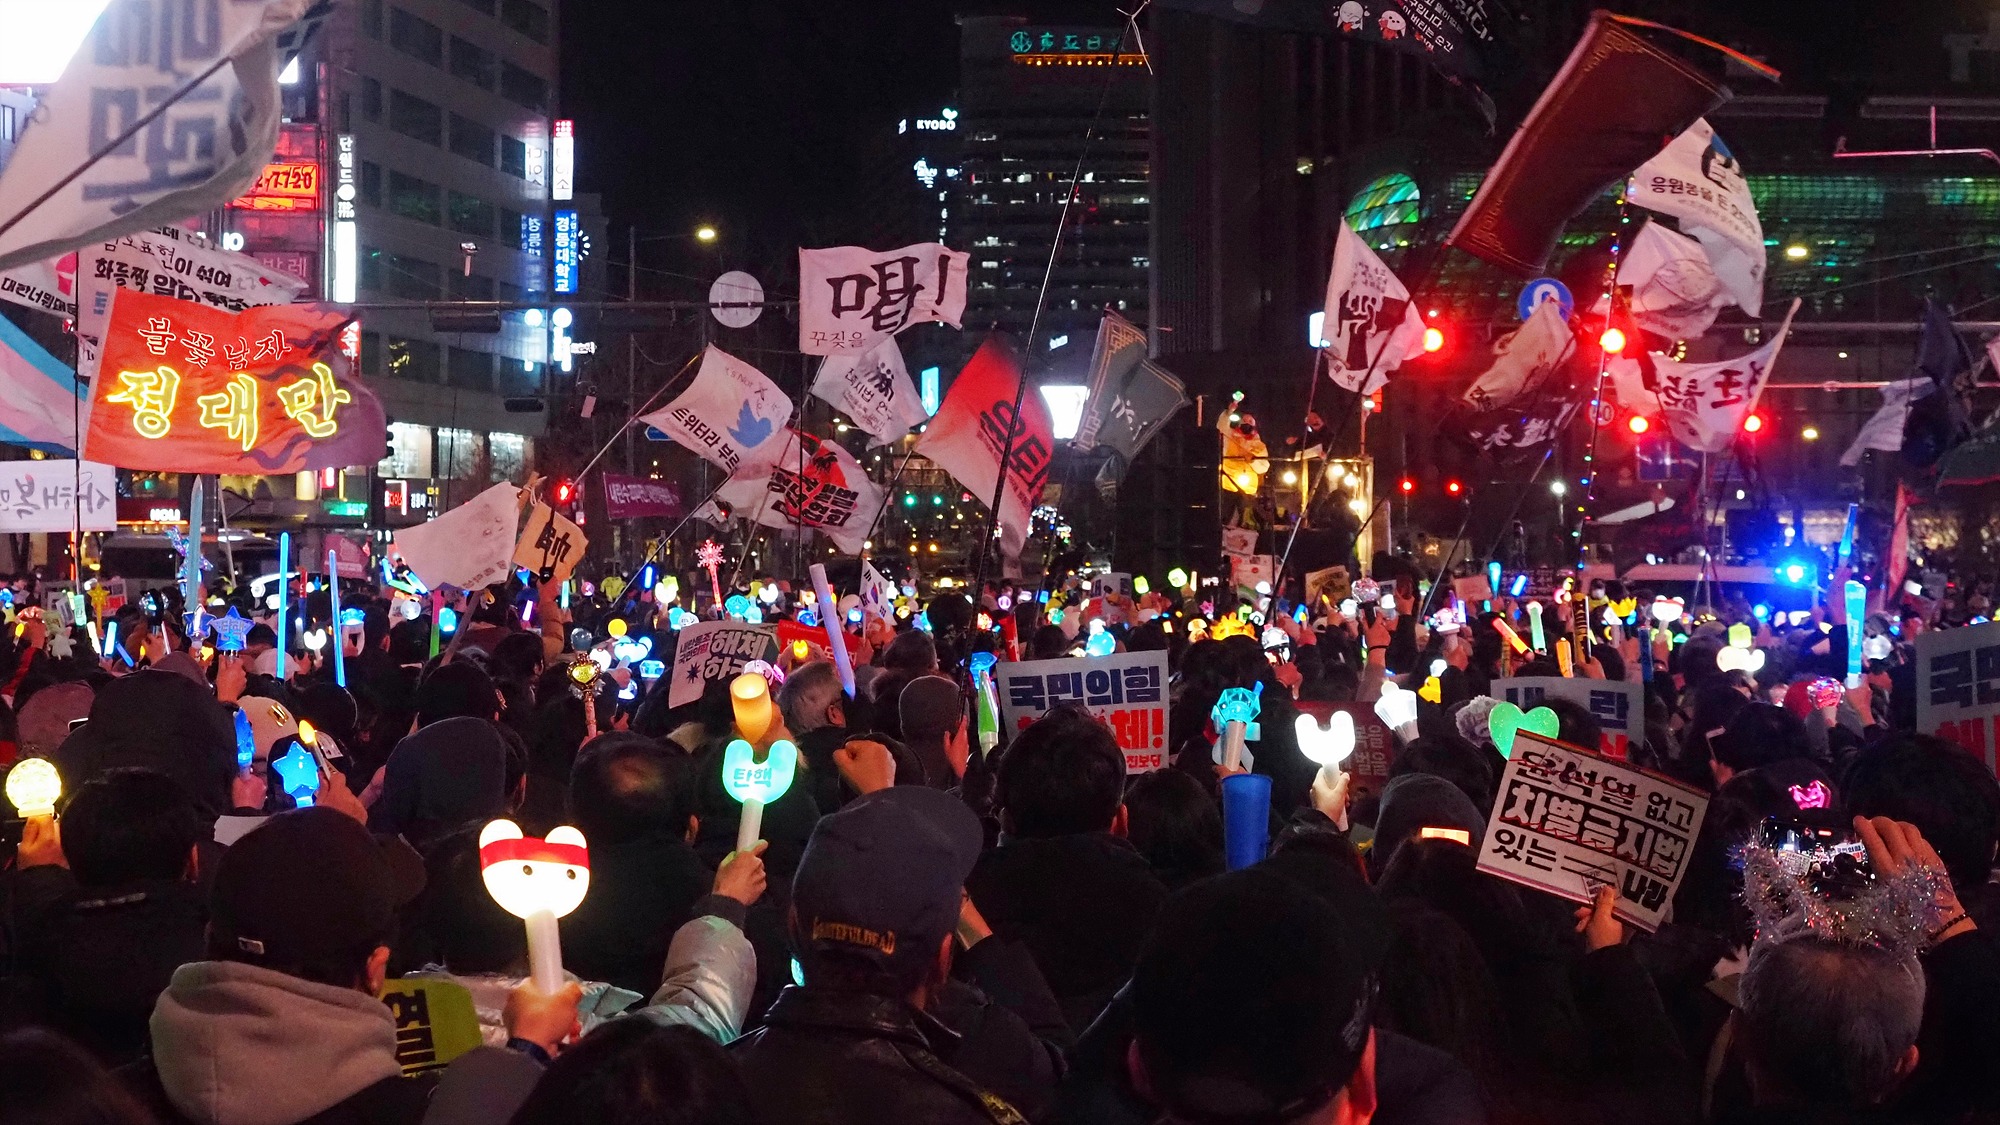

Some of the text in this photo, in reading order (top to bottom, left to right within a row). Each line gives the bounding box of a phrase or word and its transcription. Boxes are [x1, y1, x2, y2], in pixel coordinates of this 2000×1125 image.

[917, 119, 956, 131] KYOBO
[555, 217, 571, 293] 경동대학교
[138, 318, 292, 370] 불꽃남자
[810, 331, 867, 350] 꾸짖을
[107, 362, 351, 452] 정대만
[671, 408, 721, 448] 트위터라
[1009, 666, 1161, 710] 국민의힘
[733, 767, 773, 788] 탄핵
[1504, 783, 1686, 880] 차별금지법
[1644, 791, 1696, 834] 없고
[1491, 828, 1557, 873] 있는
